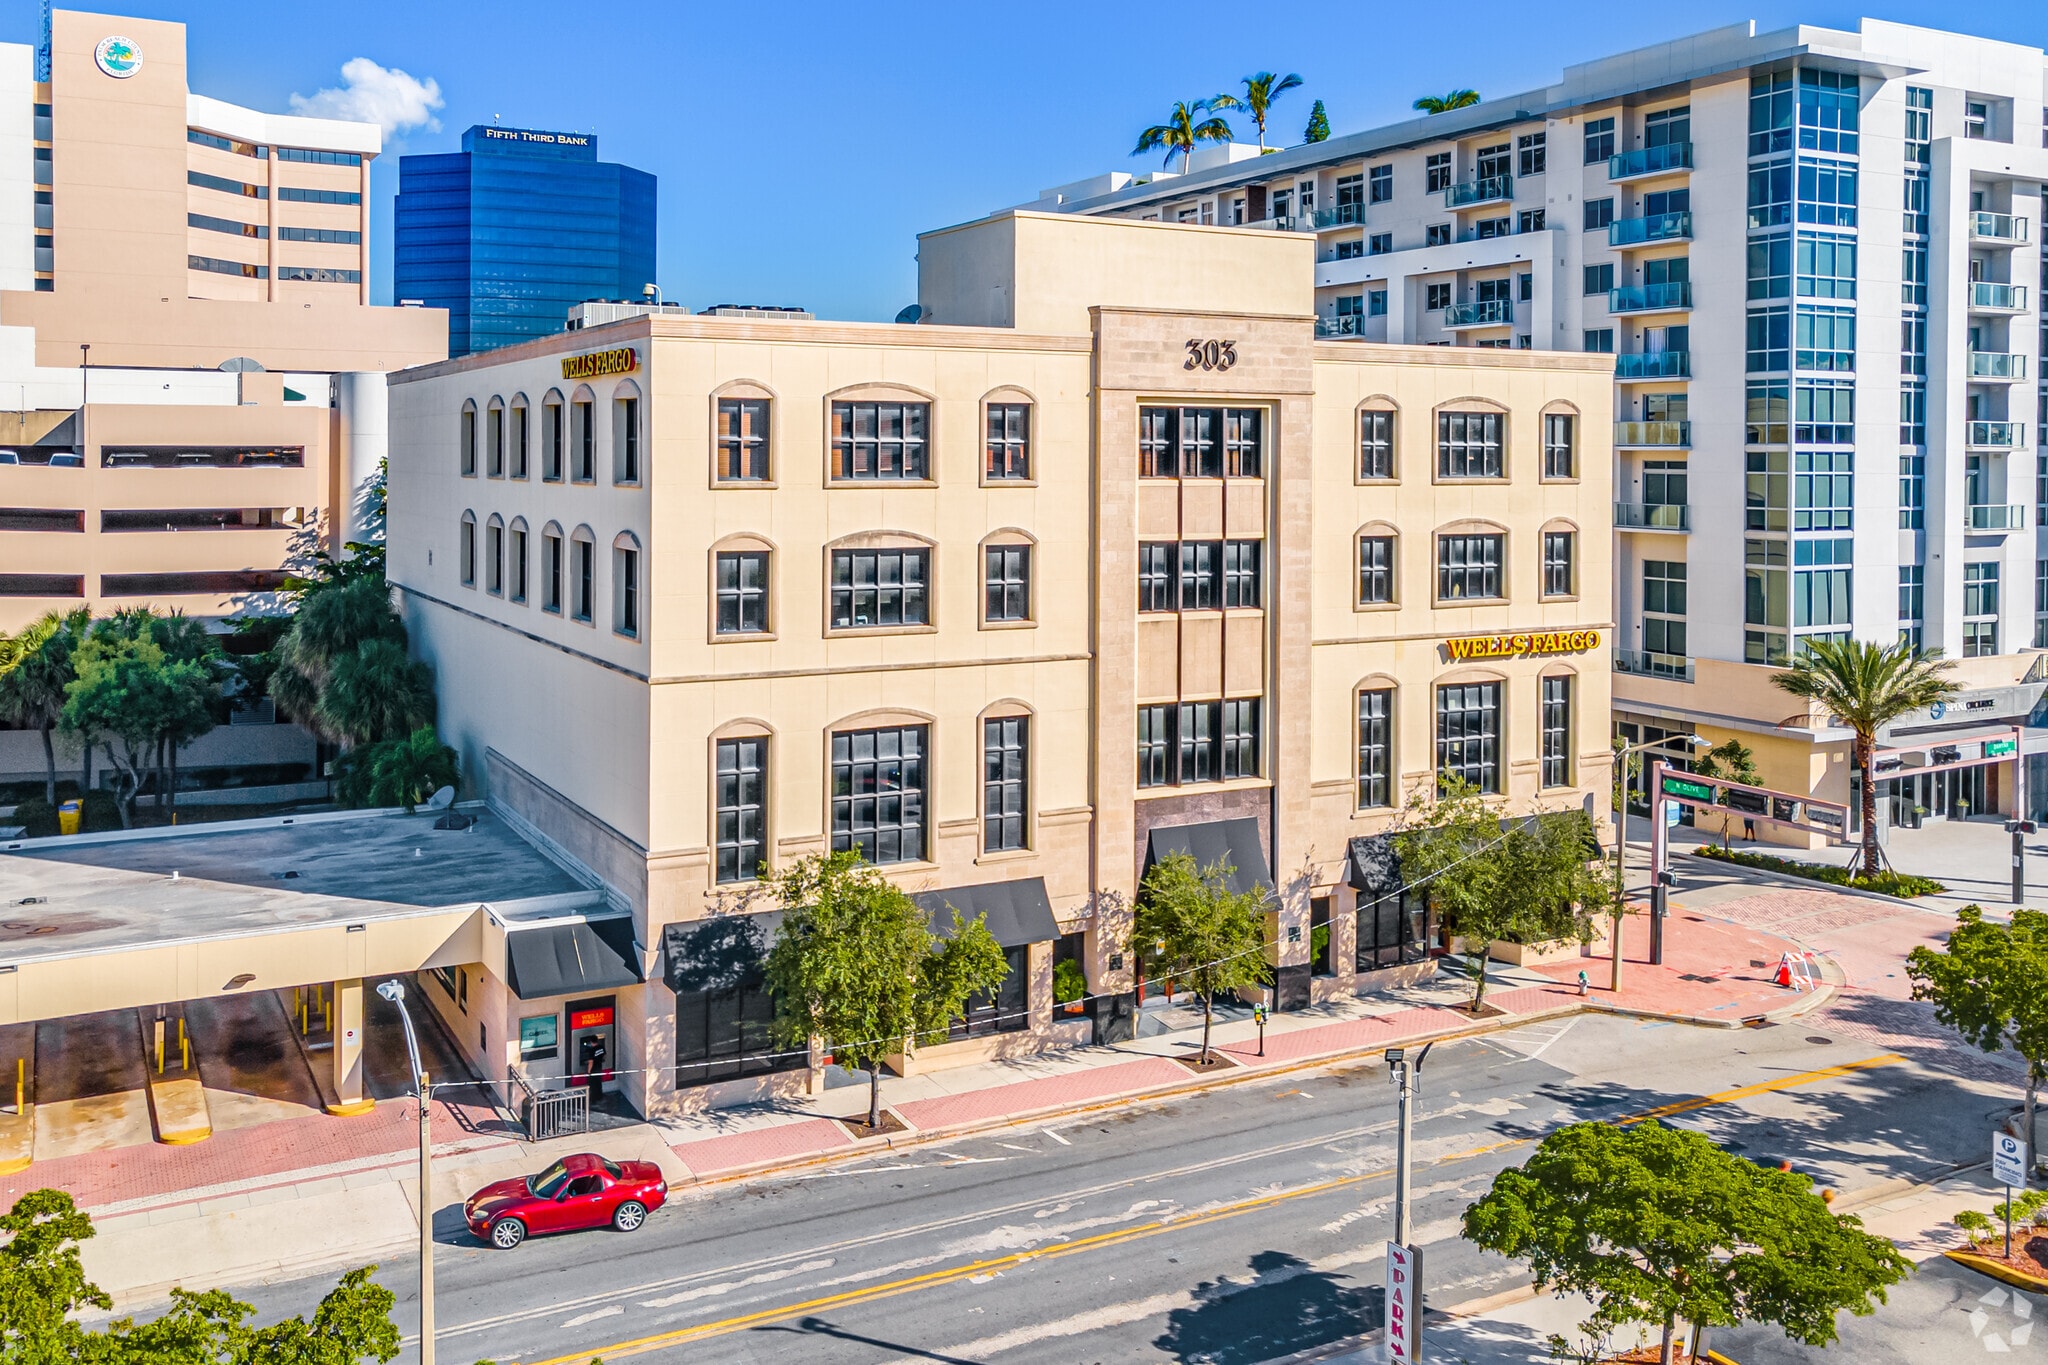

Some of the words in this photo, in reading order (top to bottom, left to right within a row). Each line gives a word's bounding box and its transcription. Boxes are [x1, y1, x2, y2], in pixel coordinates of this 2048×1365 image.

[483, 129, 518, 140] FIFTH
[521, 132, 555, 143] THIRD
[557, 135, 588, 146] BANK
[561, 353, 594, 379] WELLS
[595, 348, 632, 375] FARGO
[1184, 338, 1238, 371] 303
[1448, 635, 1527, 659] WELLS
[1530, 630, 1601, 653] FARGO
[1682, 783, 1699, 793] OLIVE
[581, 1012, 605, 1020] WELLS
[582, 1018, 605, 1026] FARGO
[1391, 1267, 1406, 1341] PARK
